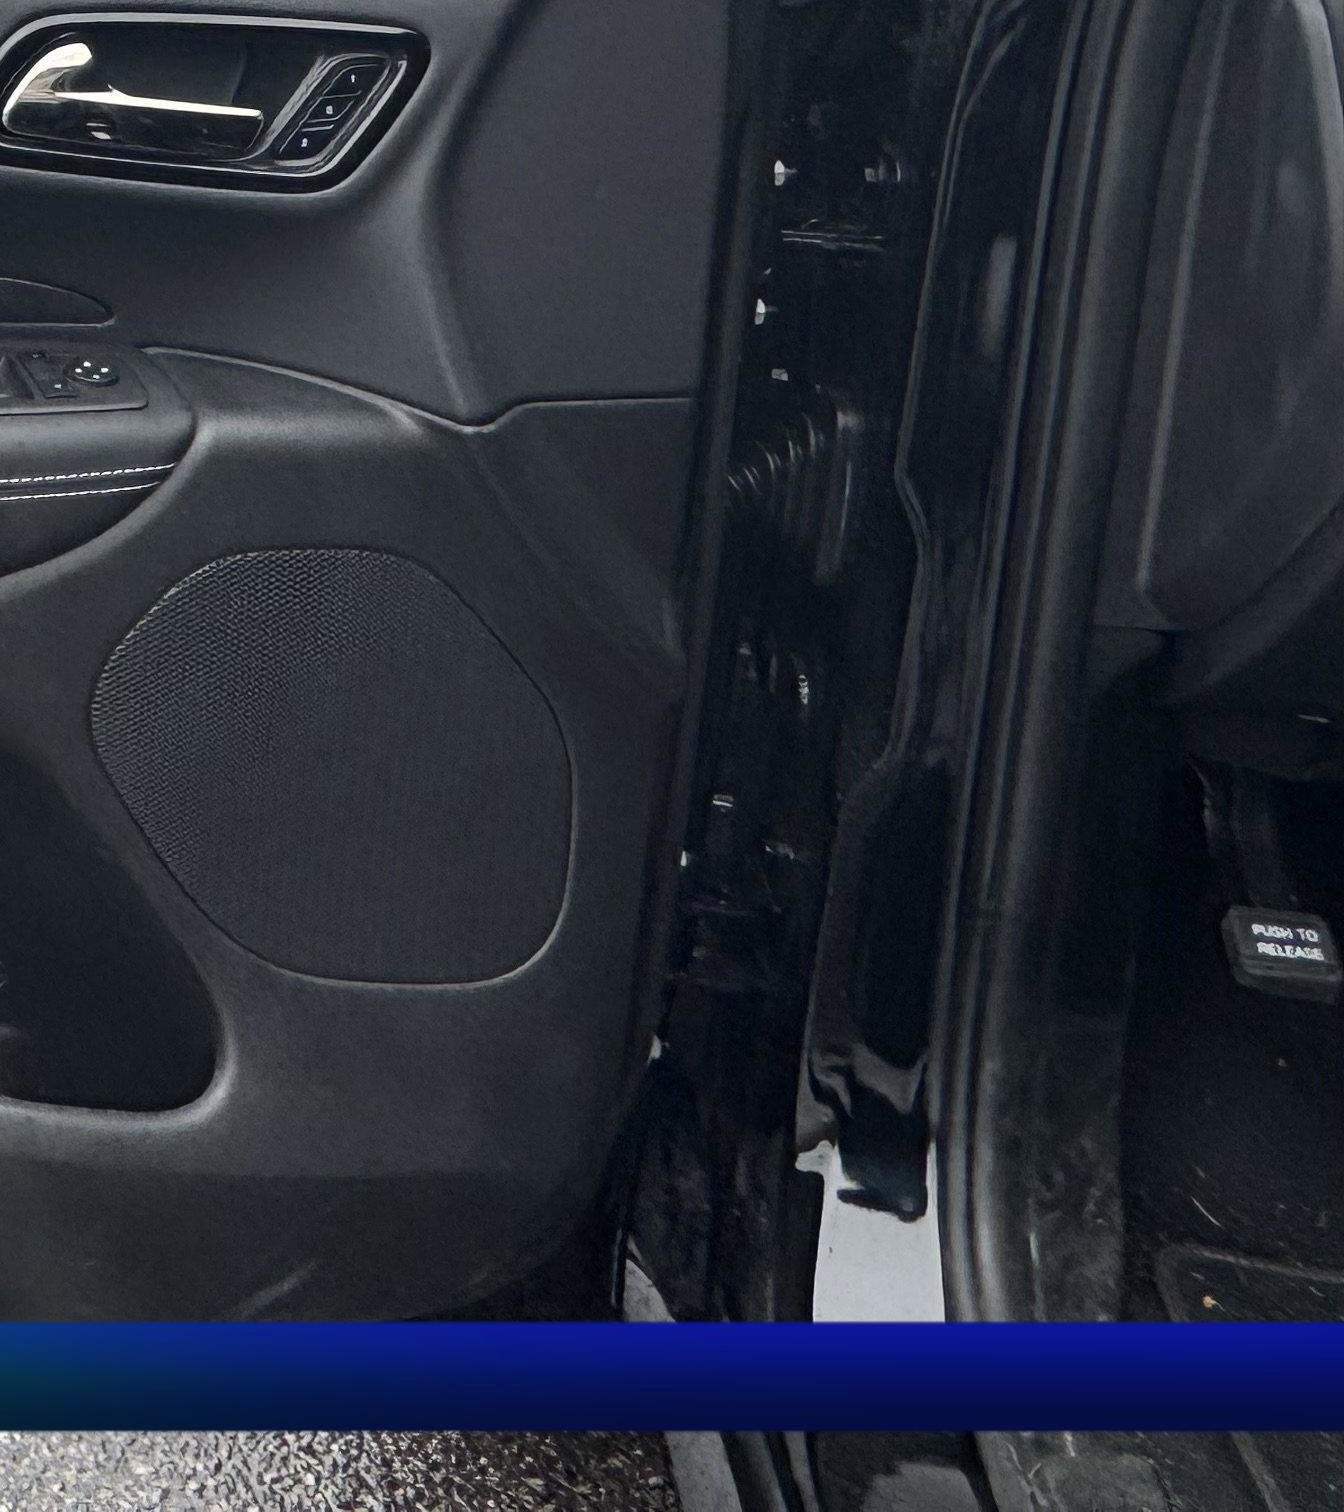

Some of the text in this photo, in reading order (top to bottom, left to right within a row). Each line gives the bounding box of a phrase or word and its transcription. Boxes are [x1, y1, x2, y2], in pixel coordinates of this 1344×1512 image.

[1251, 923, 1319, 943] PUSH TO
[1256, 941, 1325, 961] RELEASE
